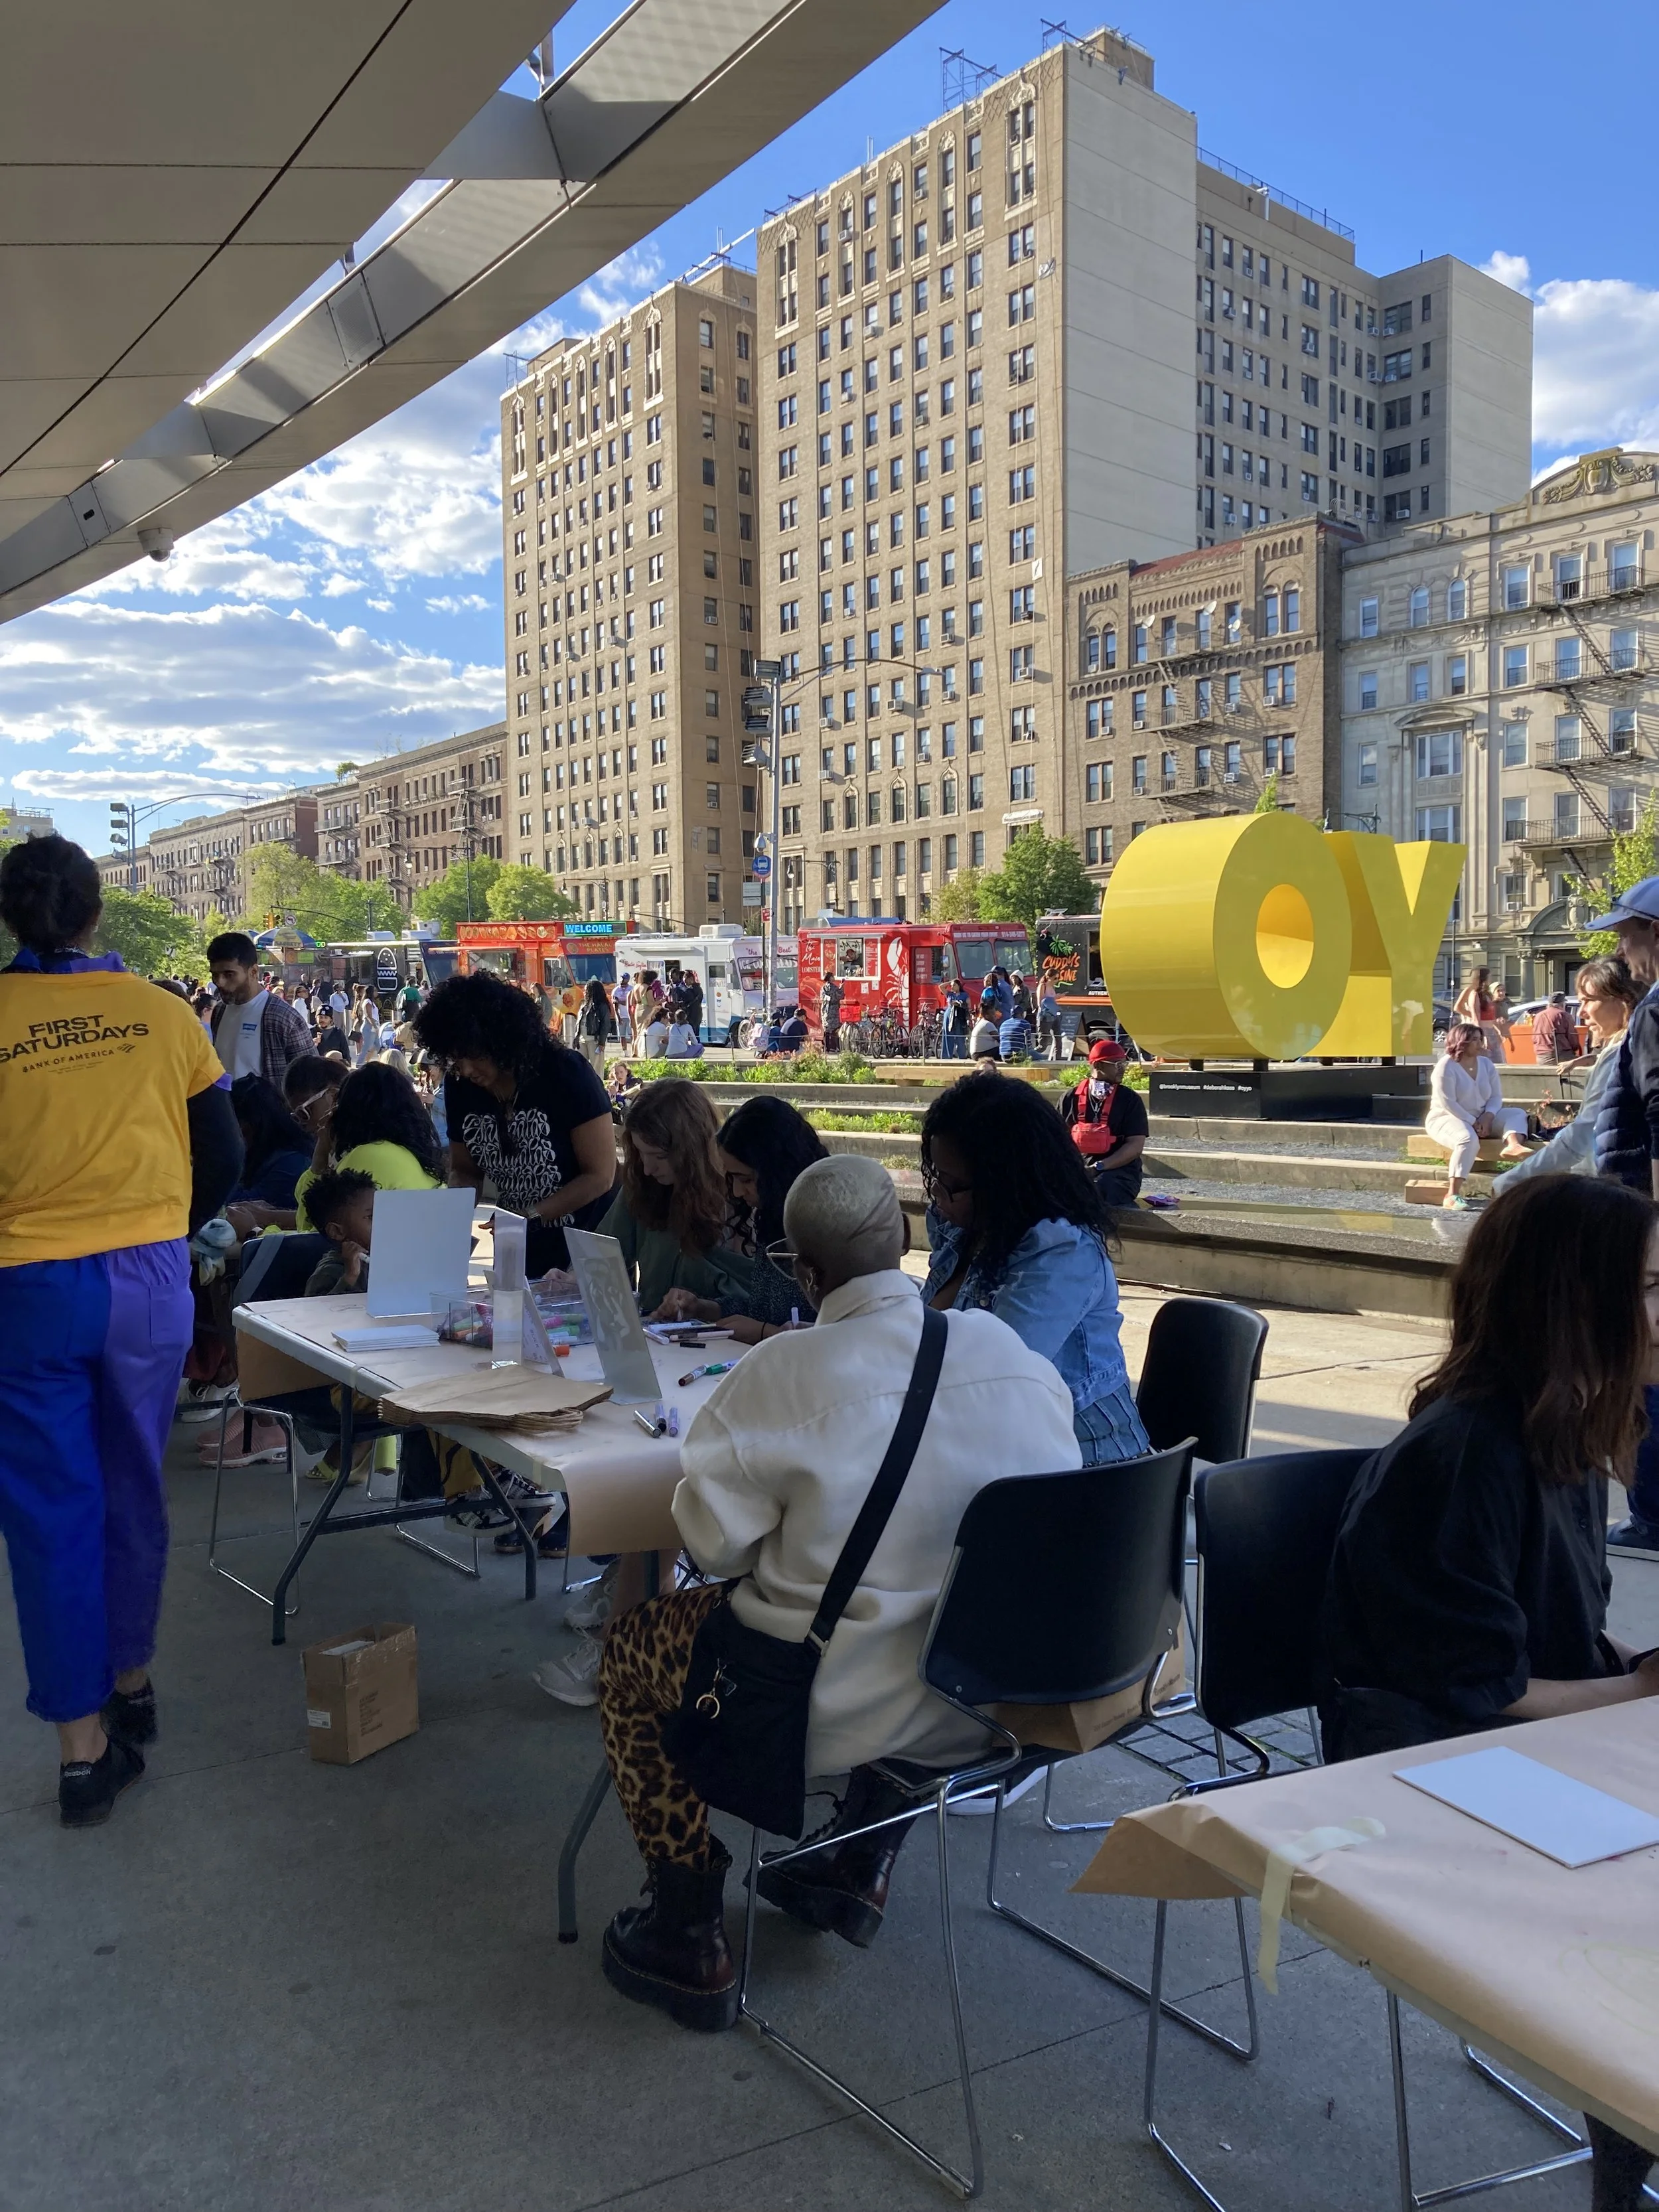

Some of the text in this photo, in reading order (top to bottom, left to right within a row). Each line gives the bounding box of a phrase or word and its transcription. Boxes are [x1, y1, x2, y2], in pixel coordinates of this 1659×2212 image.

[565, 924, 613, 933] WELCOME
[805, 940, 818, 952] The
[1042, 952, 1080, 970] CUDDY'S
[1058, 969, 1078, 982] SINE
[28, 1014, 104, 1038] FIRST
[0, 1023, 149, 1063] SATURDAYS
[22, 1061, 50, 1073] BANK
[68, 1049, 115, 1062] AMERICA
